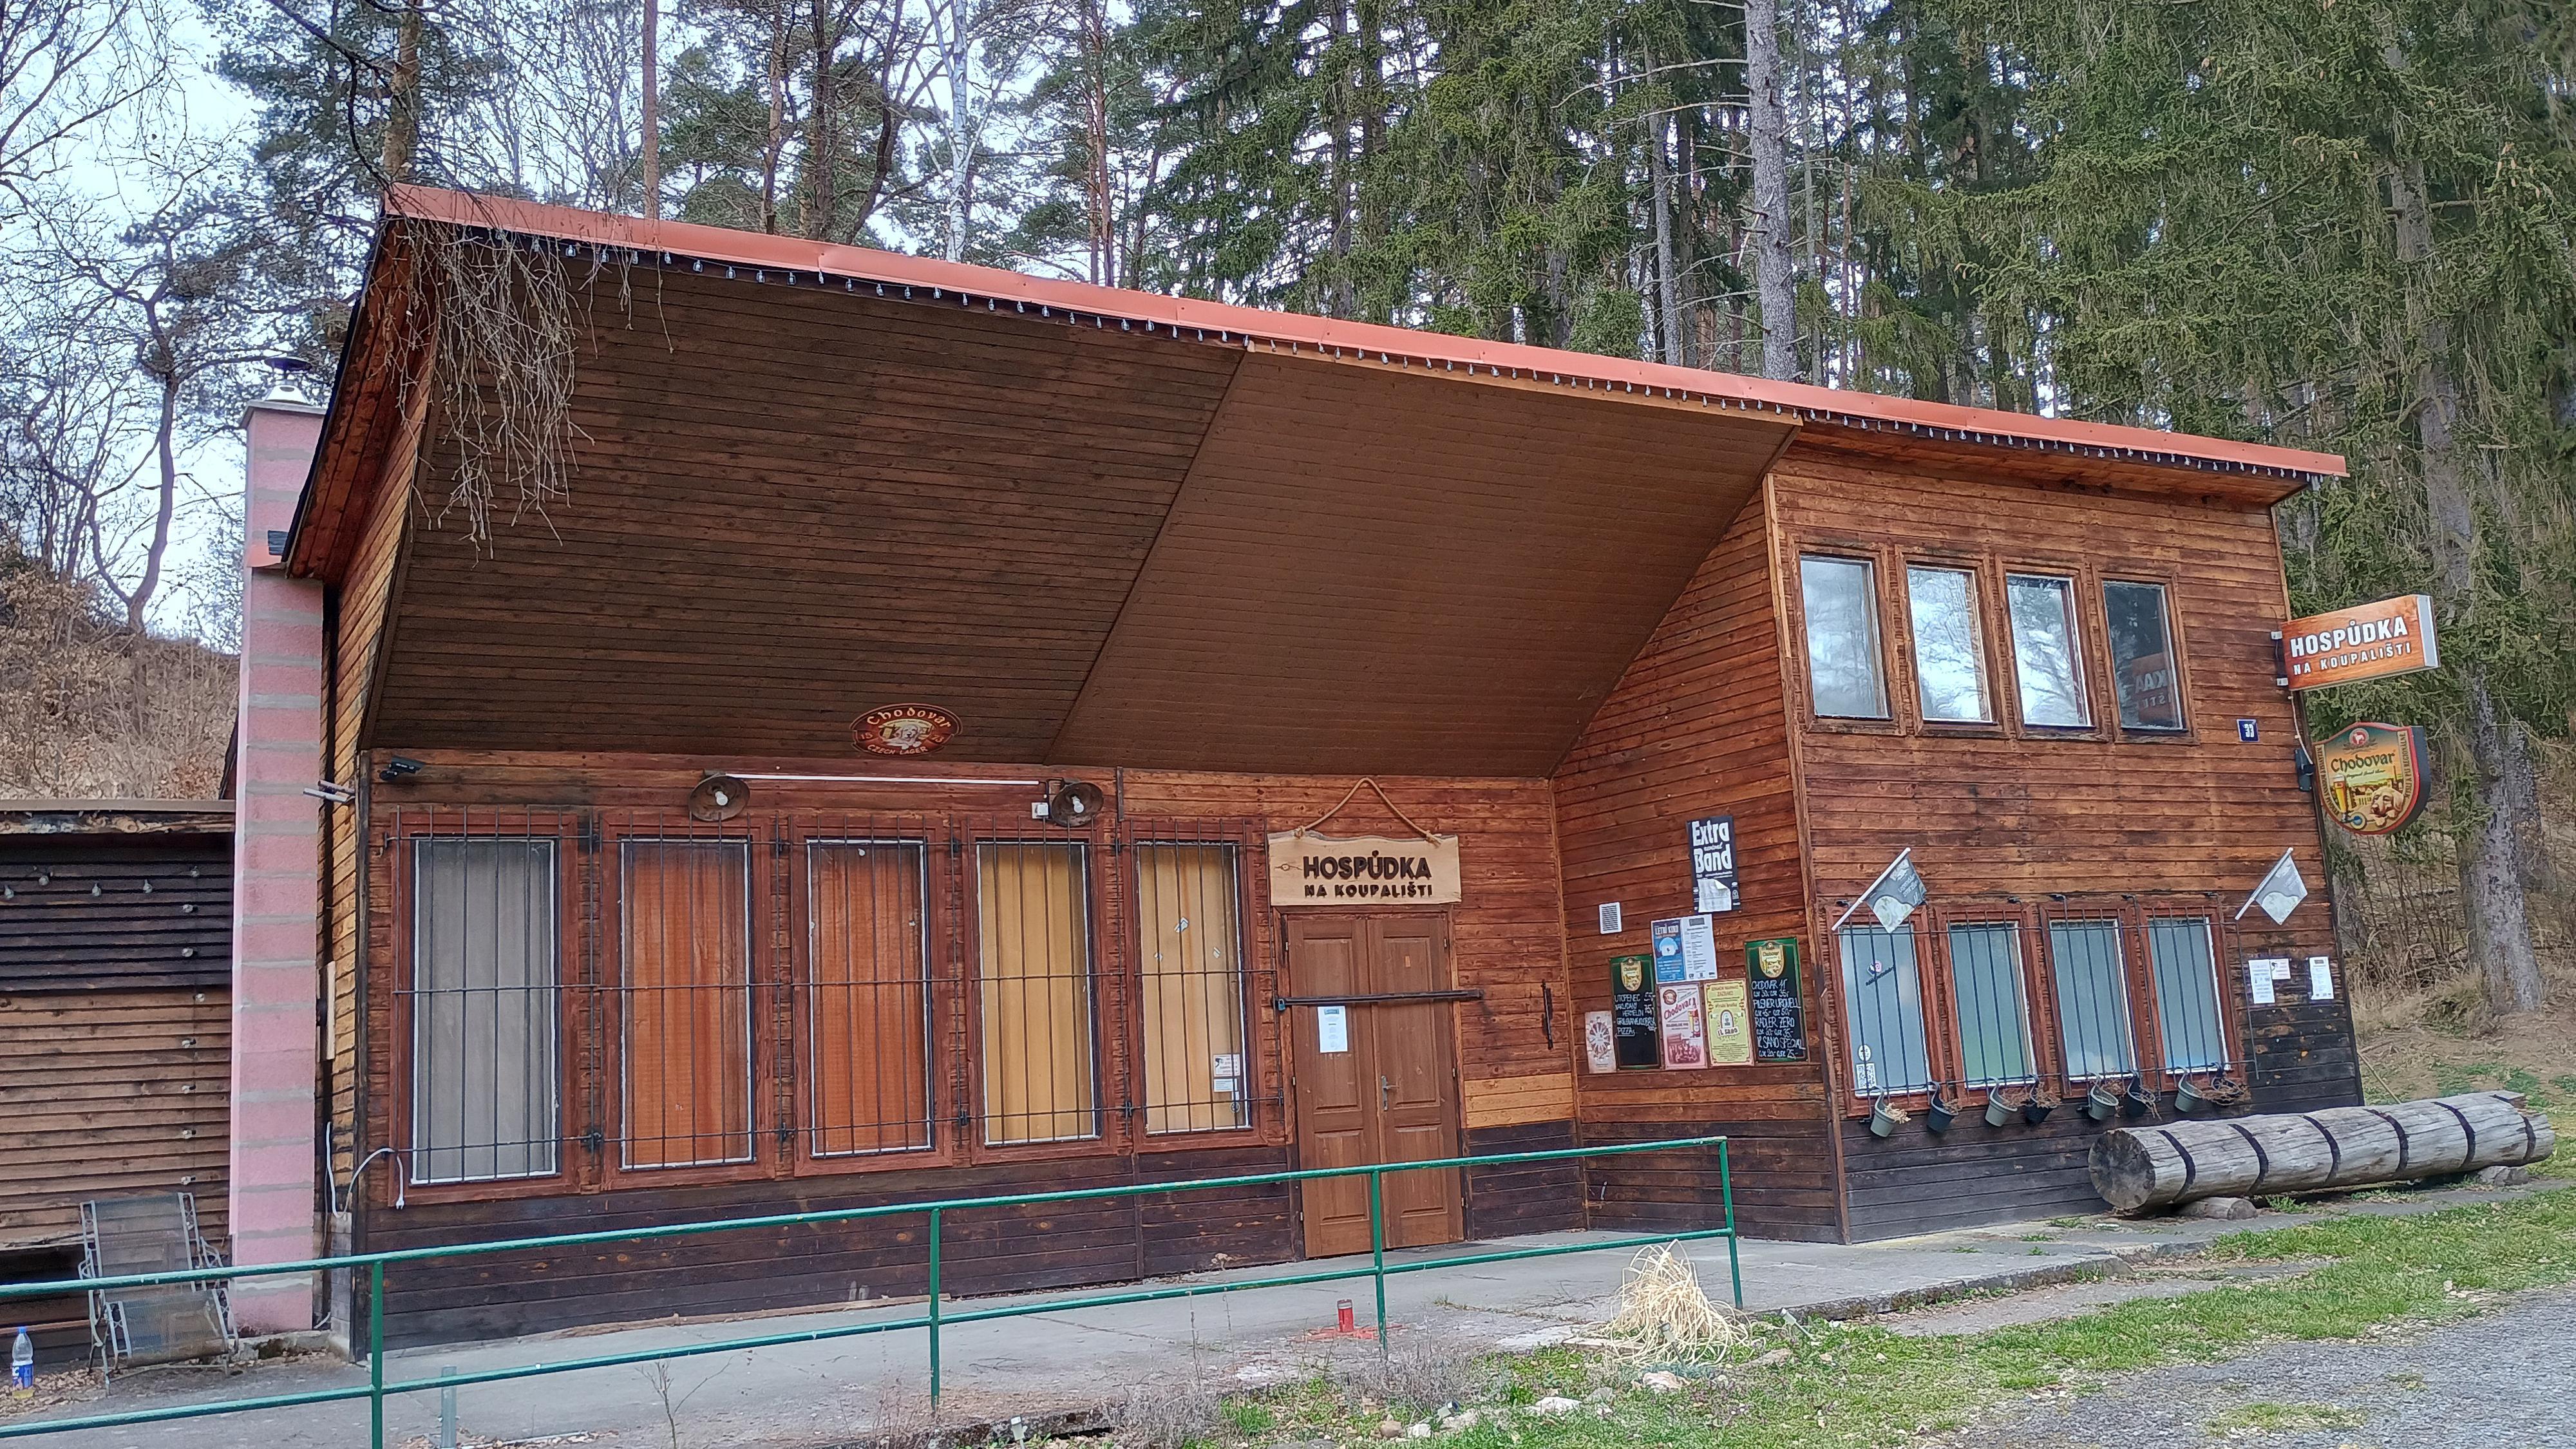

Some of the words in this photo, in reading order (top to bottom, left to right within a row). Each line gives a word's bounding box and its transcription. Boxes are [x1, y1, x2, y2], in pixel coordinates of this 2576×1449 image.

[2291, 616, 2408, 658] HOSPŮDKA
[2293, 662, 2311, 675] NA
[2320, 643, 2411, 670] KOUPALIŠTI
[867, 707, 951, 728] Chodovar
[2244, 723, 2254, 737] 33
[867, 744, 895, 755] CZECH
[900, 746, 928, 755] LAGER
[2331, 752, 2395, 773] Chodovar
[1692, 820, 1730, 846] Extra
[1303, 850, 1432, 880] HOSPŮDKA
[1694, 844, 1732, 873] Band
[1304, 884, 1327, 897] NA
[1335, 881, 1432, 898] KOUPALIŠTI
[1615, 994, 1640, 1002] UTOPENEC
[1664, 998, 1691, 1019] Chodovar
[1617, 1027, 1633, 1035] PIZZA
[1778, 1016, 1794, 1028] ZERO
[1763, 1036, 1779, 1048] SANO
